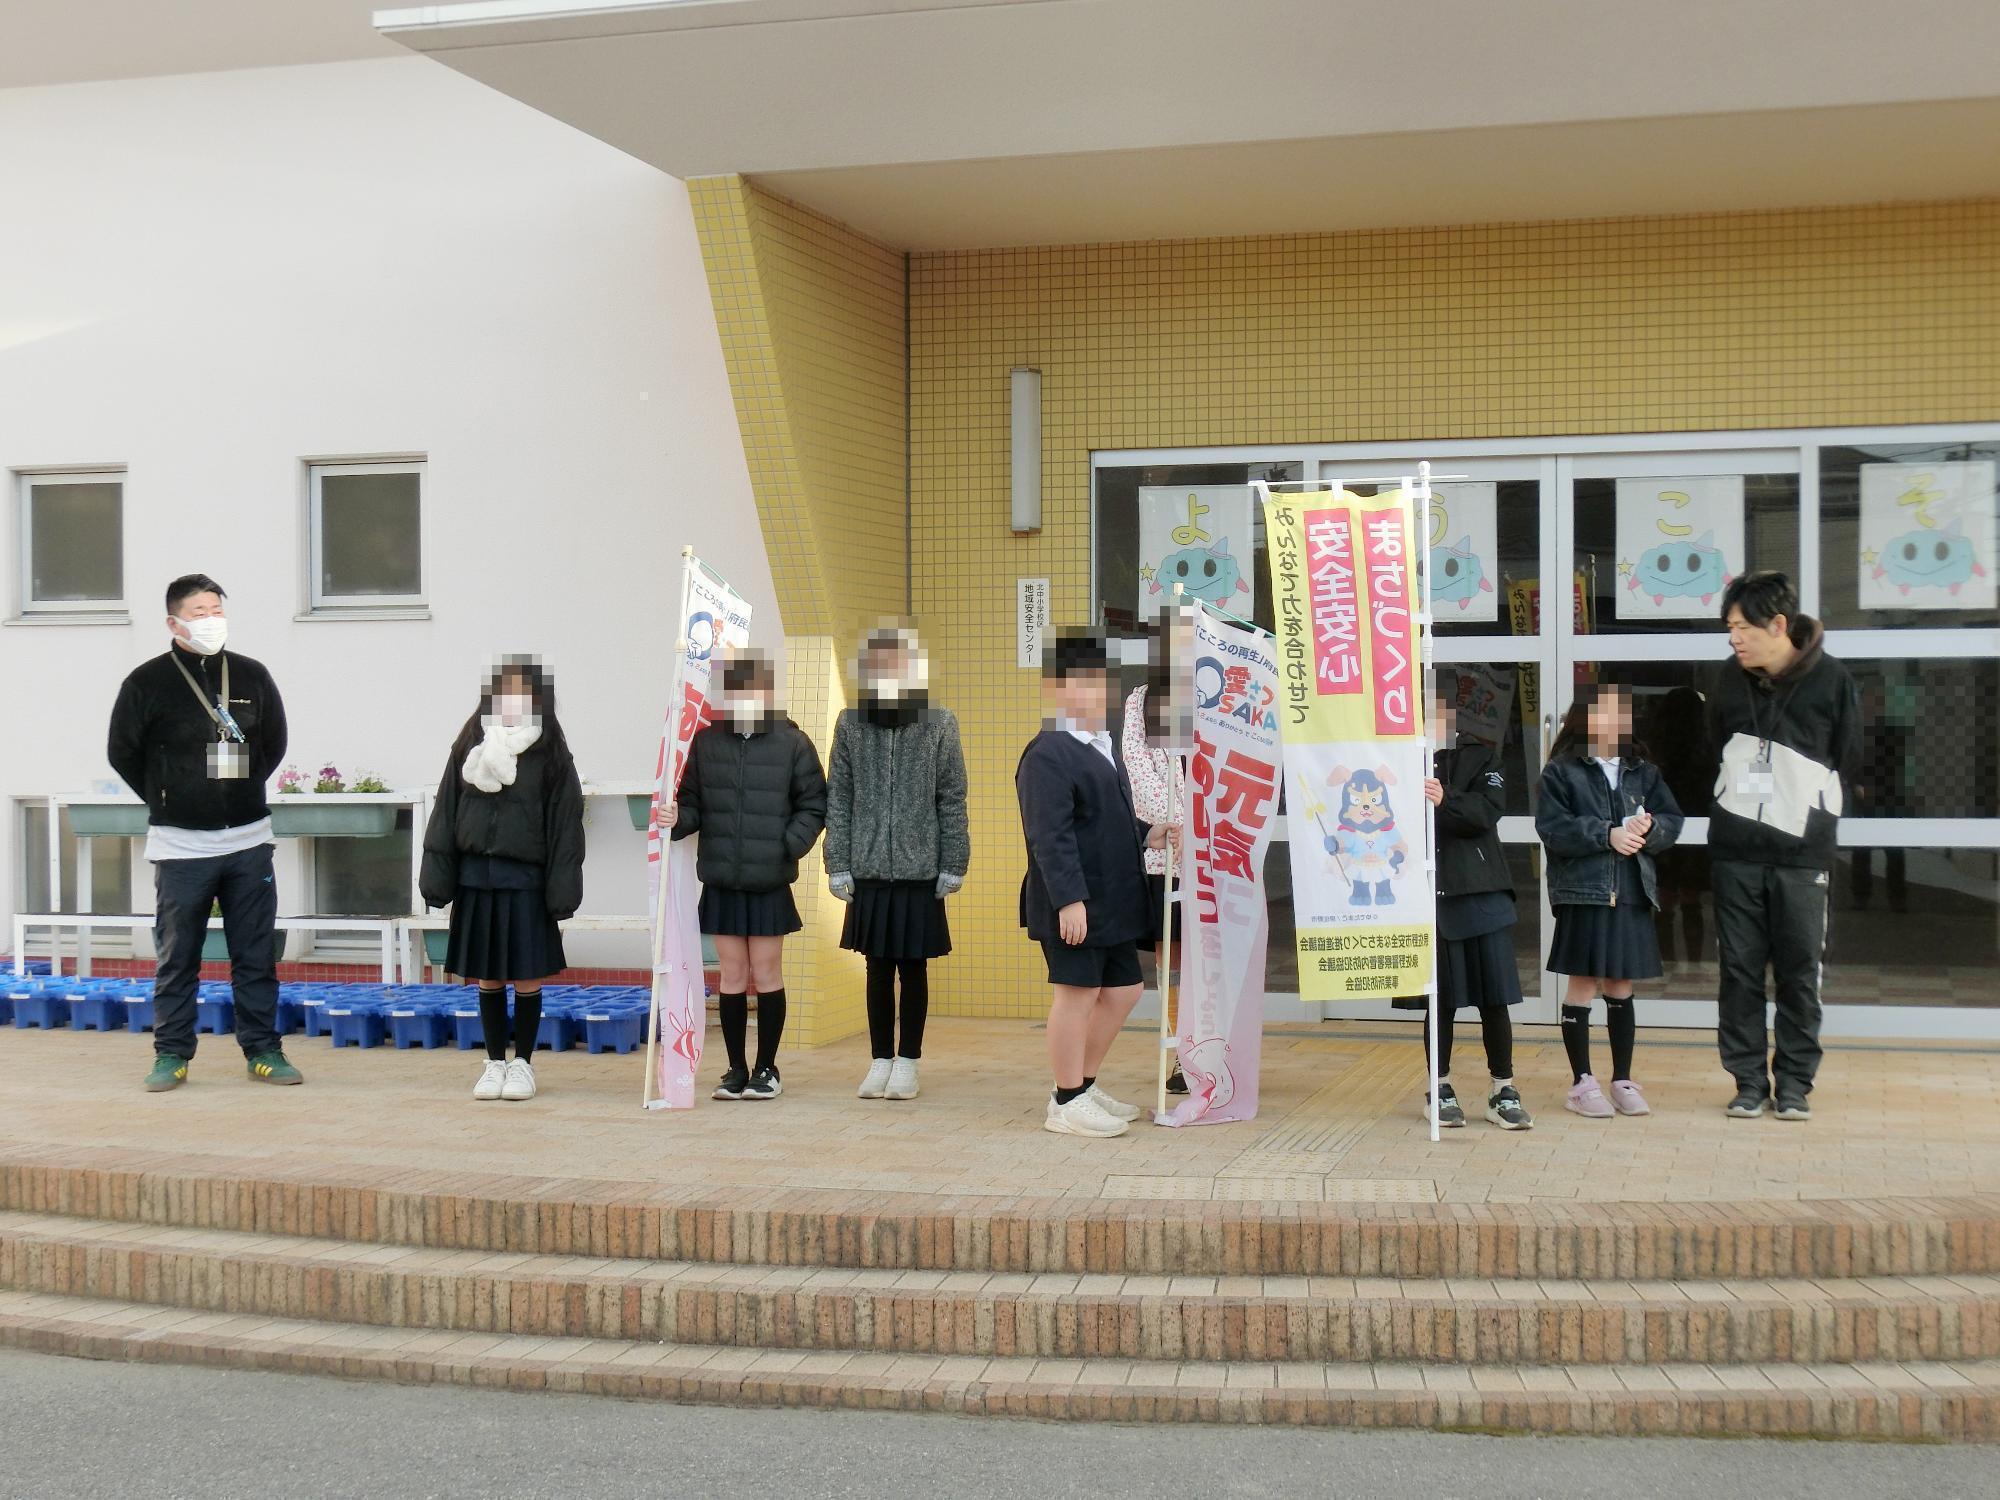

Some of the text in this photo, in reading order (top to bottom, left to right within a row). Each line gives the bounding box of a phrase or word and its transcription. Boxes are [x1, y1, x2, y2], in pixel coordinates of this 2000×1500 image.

[1171, 493, 1211, 544] よ
[1657, 490, 1693, 536] こ
[1897, 472, 1946, 529] そ
[1024, 583, 1034, 664] 地域安全センター
